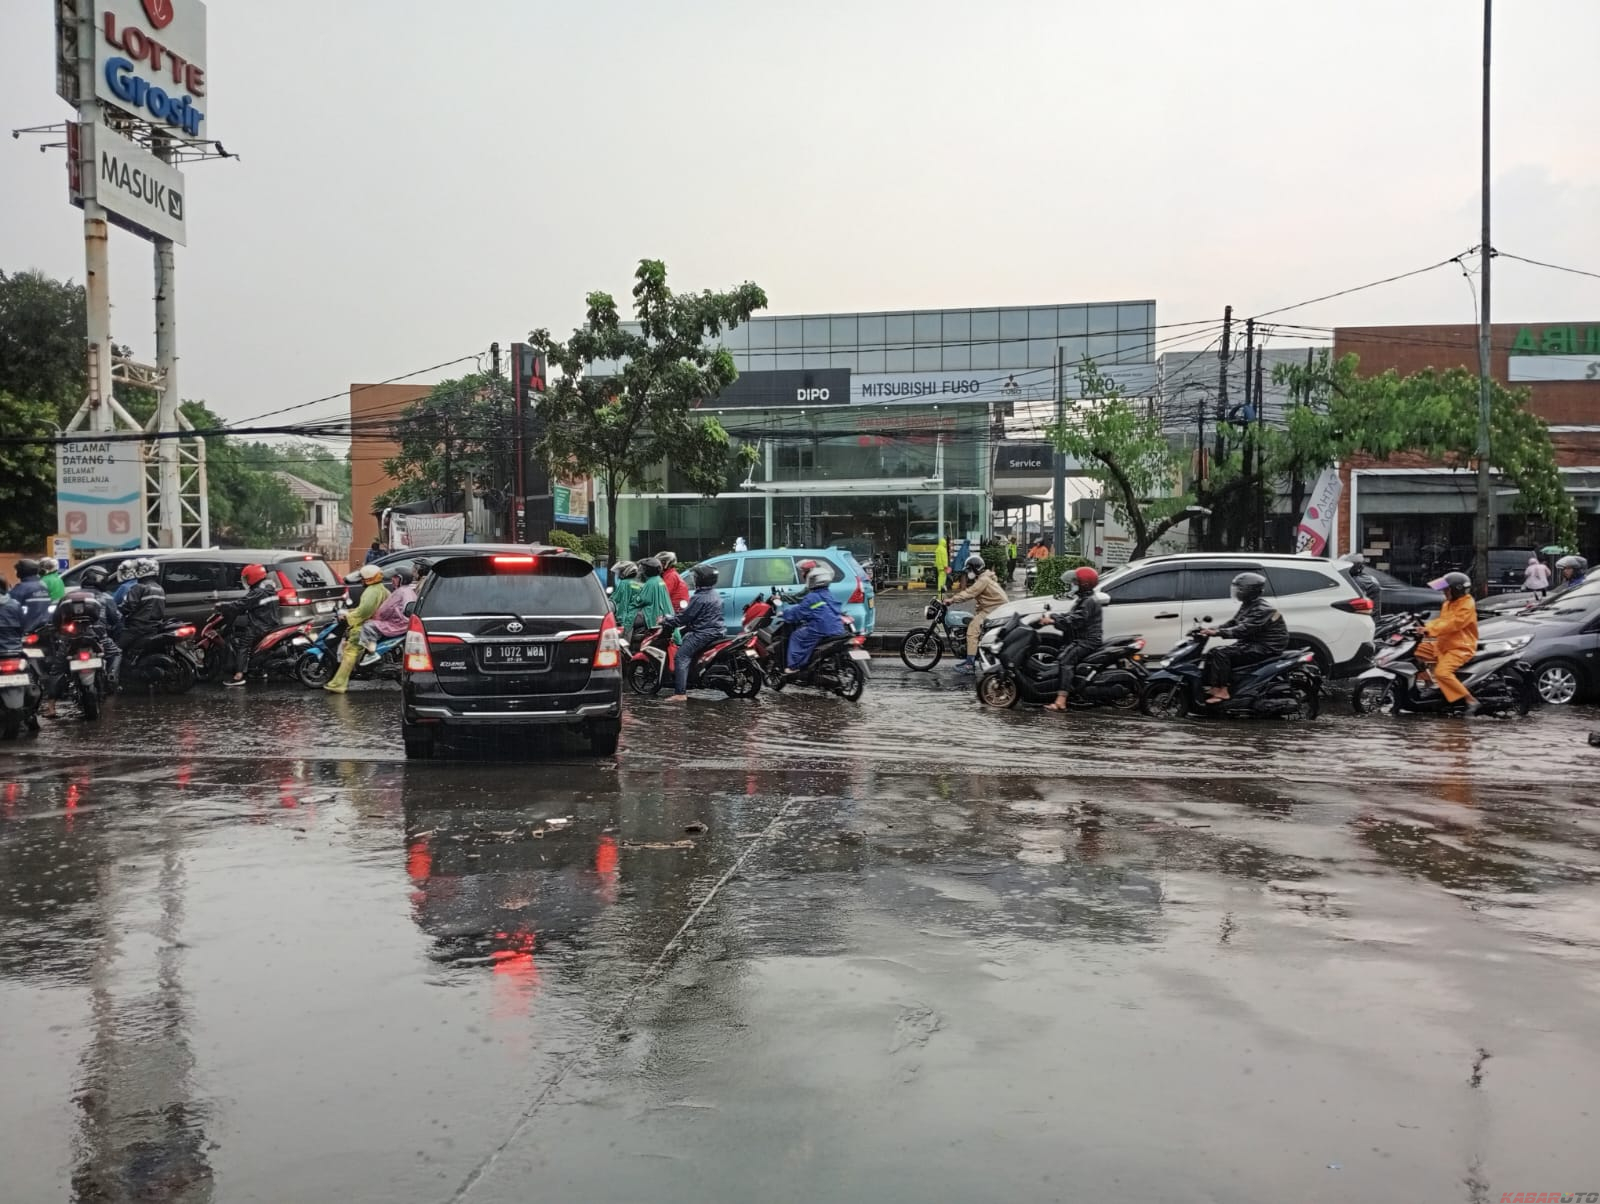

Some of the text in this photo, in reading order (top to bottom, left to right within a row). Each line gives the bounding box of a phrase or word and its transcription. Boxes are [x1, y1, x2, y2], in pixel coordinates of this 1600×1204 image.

[104, 11, 205, 97] LOTTE
[105, 56, 205, 137] Grosir
[102, 151, 165, 212] MASUK
[862, 379, 980, 398] MITSUBISHI FUSO
[1081, 378, 1114, 392] DPO
[797, 388, 830, 401] DIPO
[63, 443, 111, 453] SELAMAT
[63, 455, 104, 465] DATANG
[1009, 459, 1041, 468] Service
[63, 467, 95, 475] SELAMAT
[63, 476, 109, 484] BERBELANJA
[486, 647, 492, 657] B
[500, 646, 521, 657] 1072
